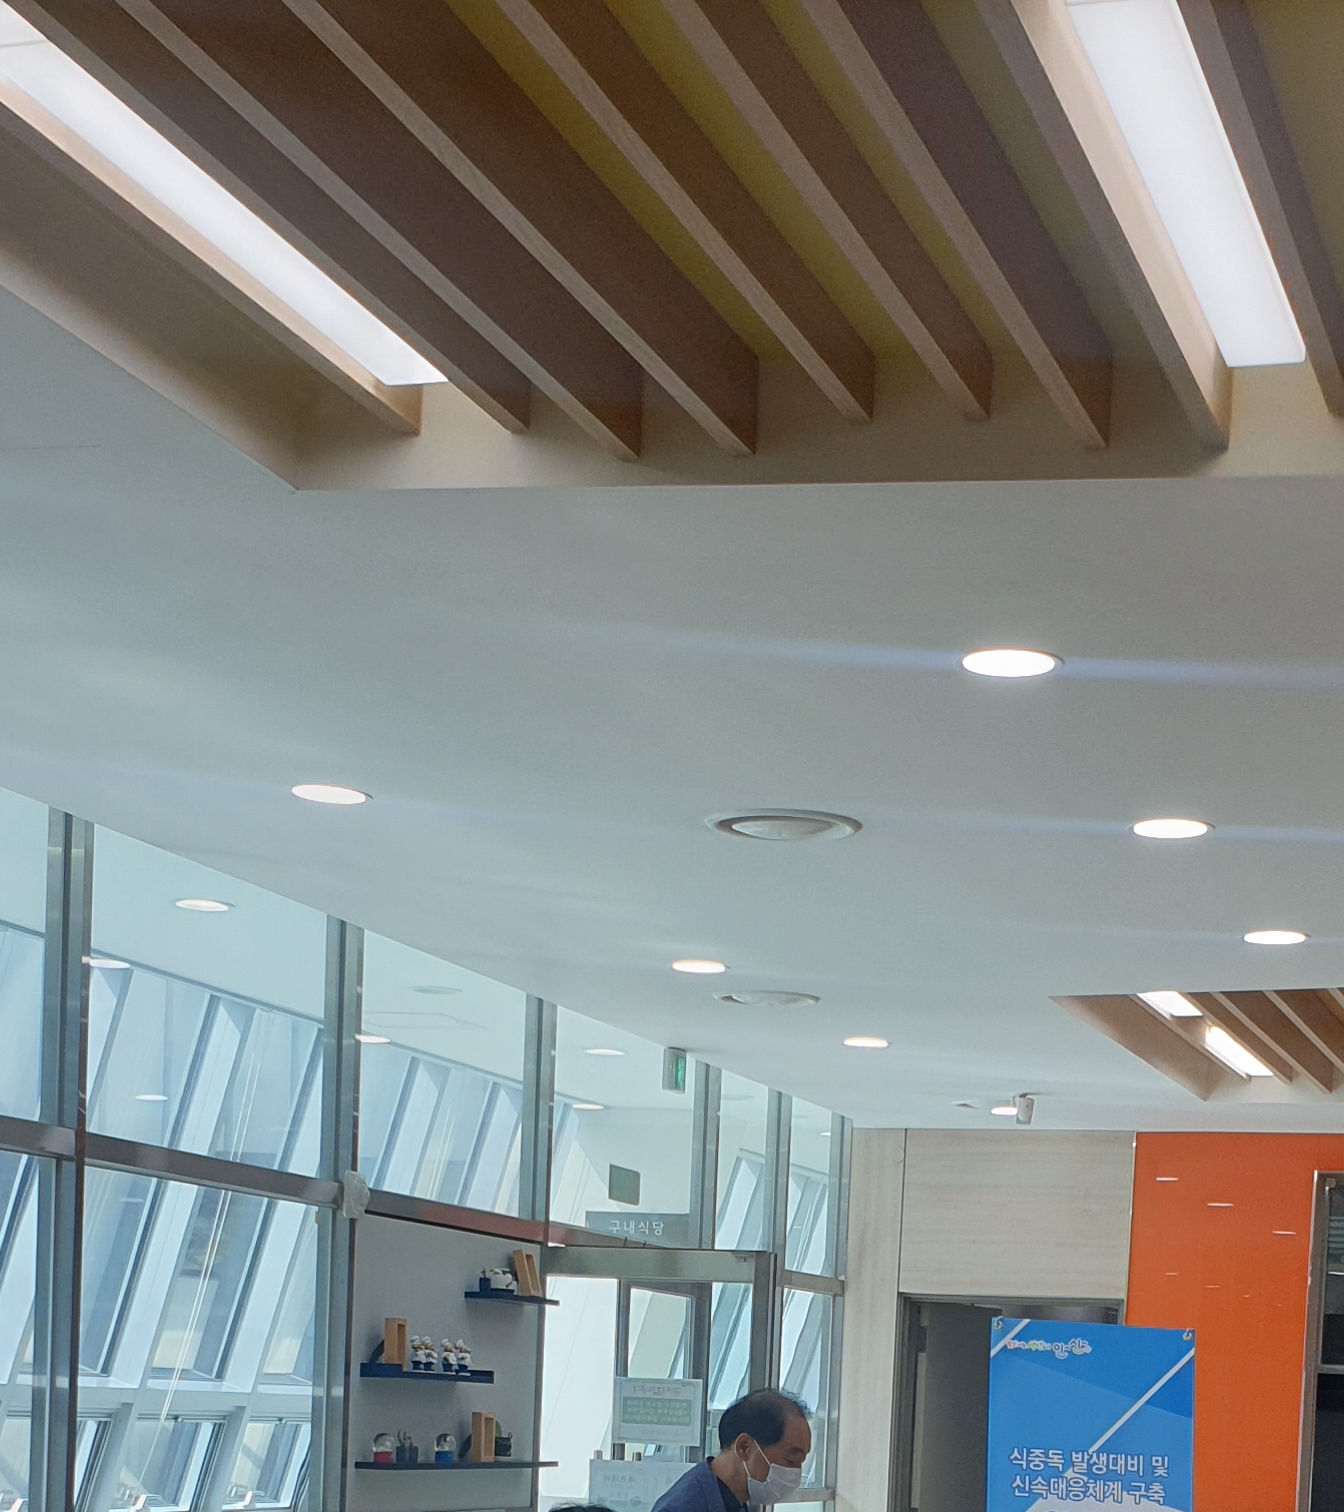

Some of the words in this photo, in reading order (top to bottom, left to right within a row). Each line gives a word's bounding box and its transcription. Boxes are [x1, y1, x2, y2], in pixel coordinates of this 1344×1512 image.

[609, 1220, 665, 1236] 구내식당
[1010, 1447, 1065, 1472] 식중독
[1072, 1451, 1144, 1477] 발생대비
[1152, 1456, 1169, 1478] 및
[1012, 1475, 1123, 1503] 신속대응체계
[1128, 1482, 1166, 1505] 구축
